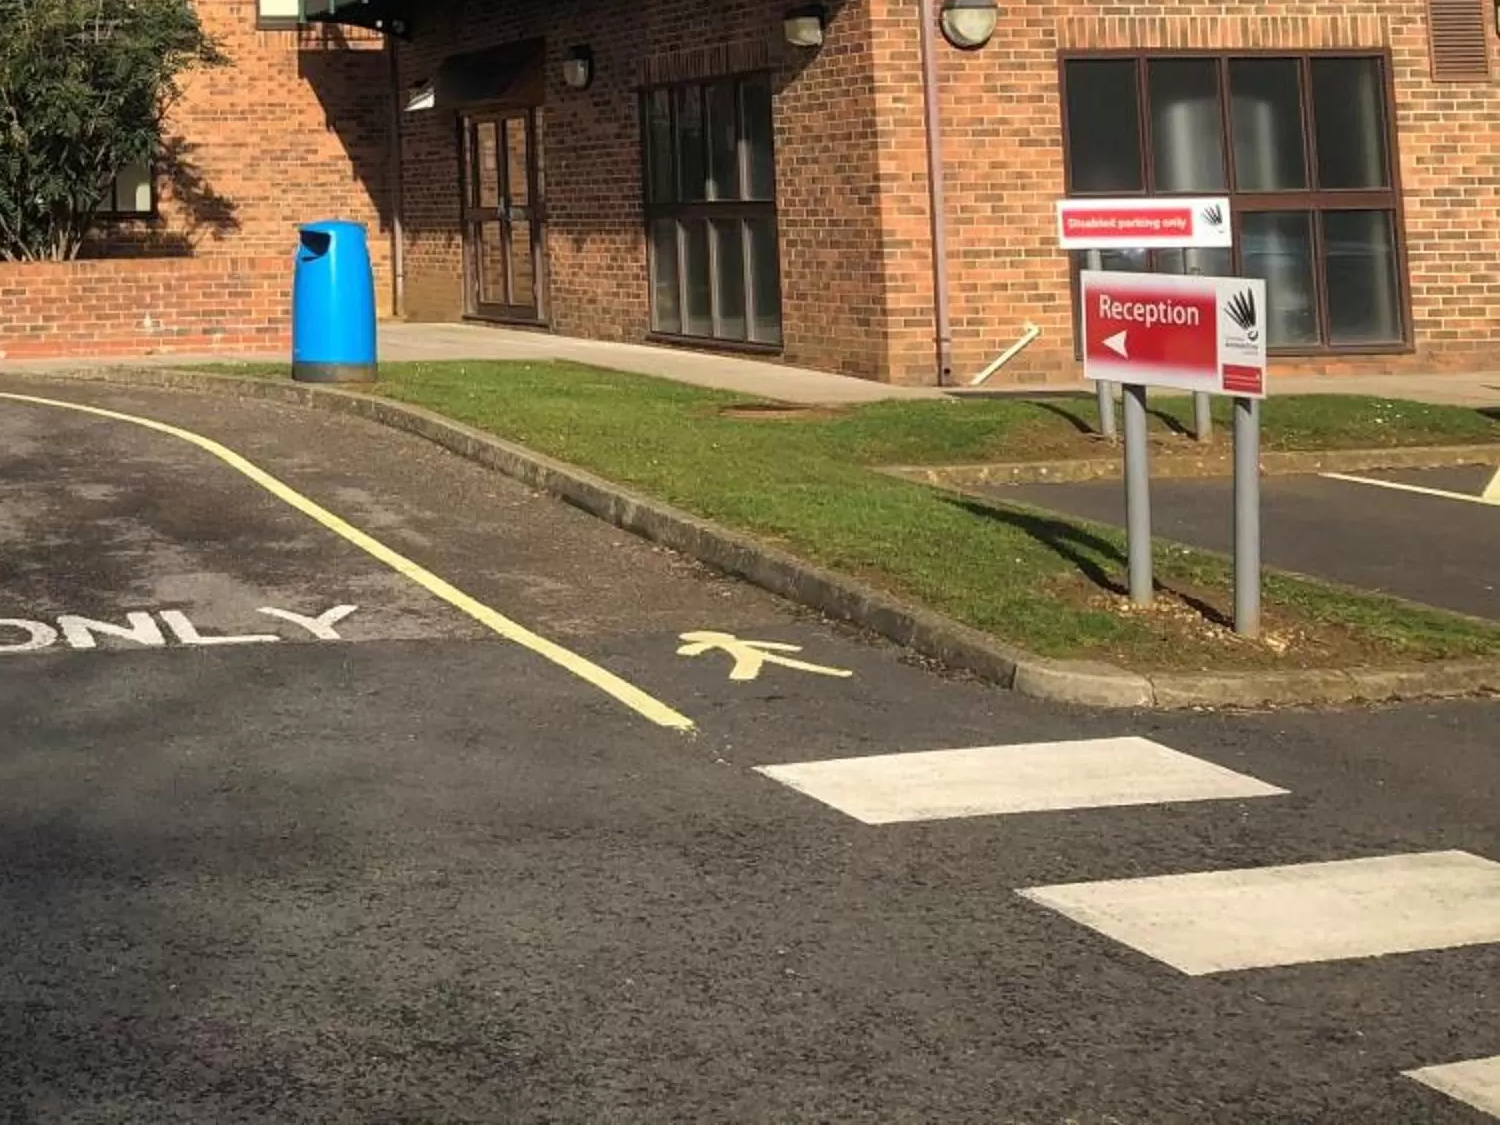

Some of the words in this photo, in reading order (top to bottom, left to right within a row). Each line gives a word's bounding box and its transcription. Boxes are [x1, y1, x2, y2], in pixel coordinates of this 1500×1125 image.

[1118, 218, 1160, 230] parking
[1162, 218, 1186, 230] only
[1099, 294, 1199, 327] Reception
